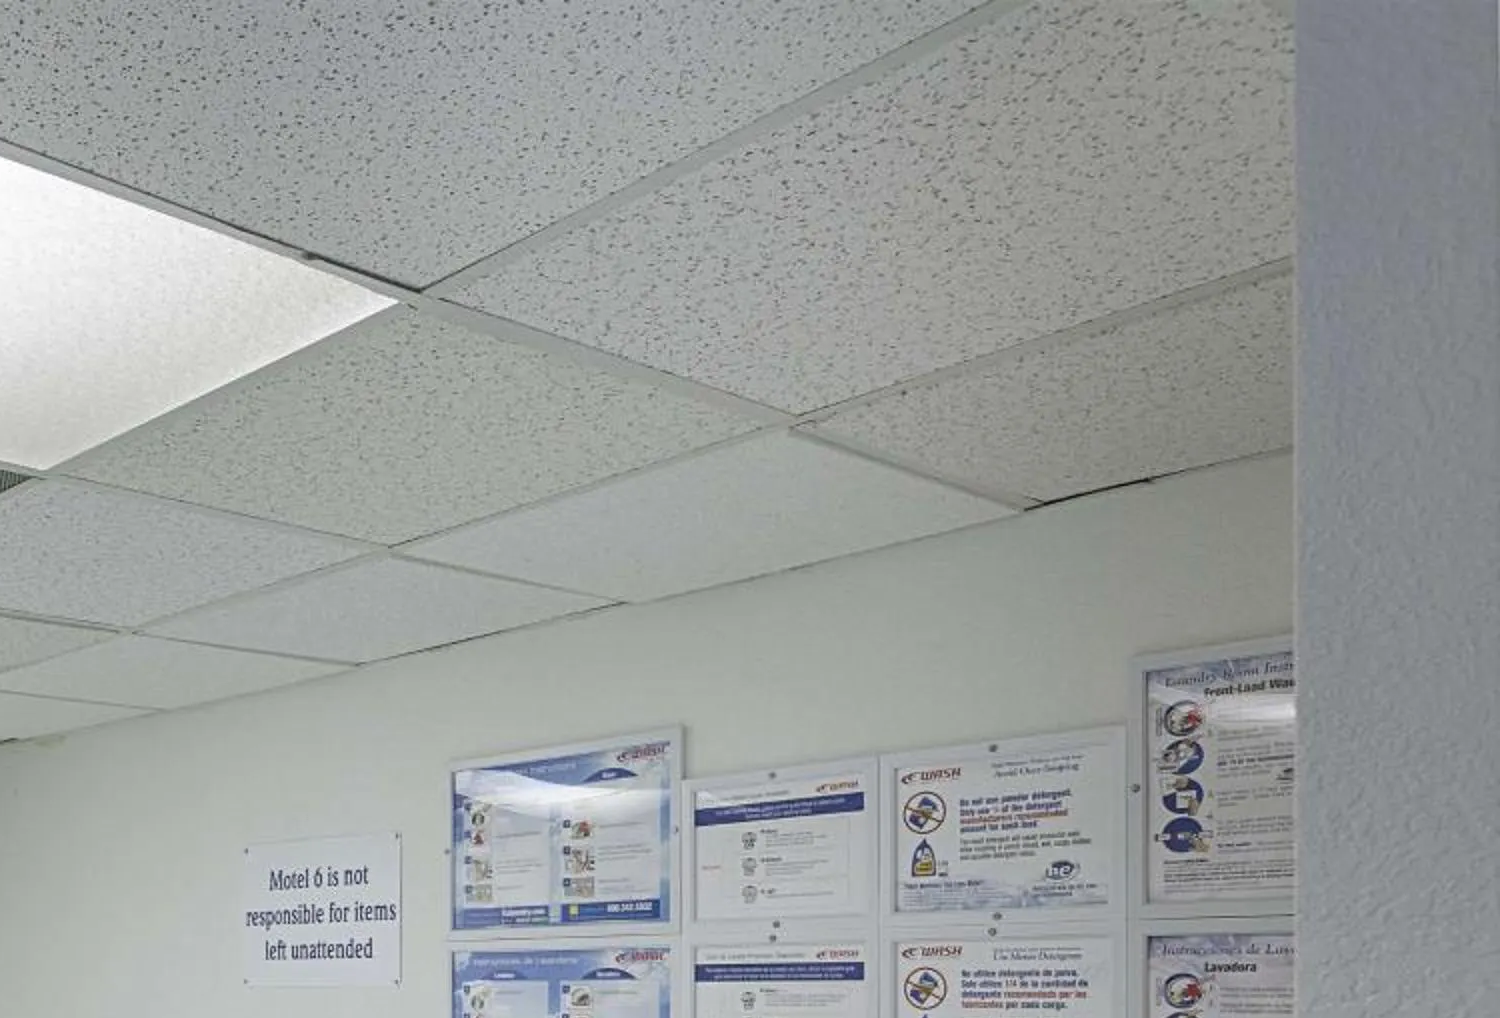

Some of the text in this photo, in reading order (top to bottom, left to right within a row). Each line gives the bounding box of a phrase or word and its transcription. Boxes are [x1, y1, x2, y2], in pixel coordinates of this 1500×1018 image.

[920, 768, 962, 781] WASH
[269, 865, 369, 891] Motel 6 is not
[245, 901, 397, 931] responsible for items
[265, 937, 373, 960] left unattended
[921, 946, 963, 957] WASH
[1204, 961, 1257, 973] Lavadora
